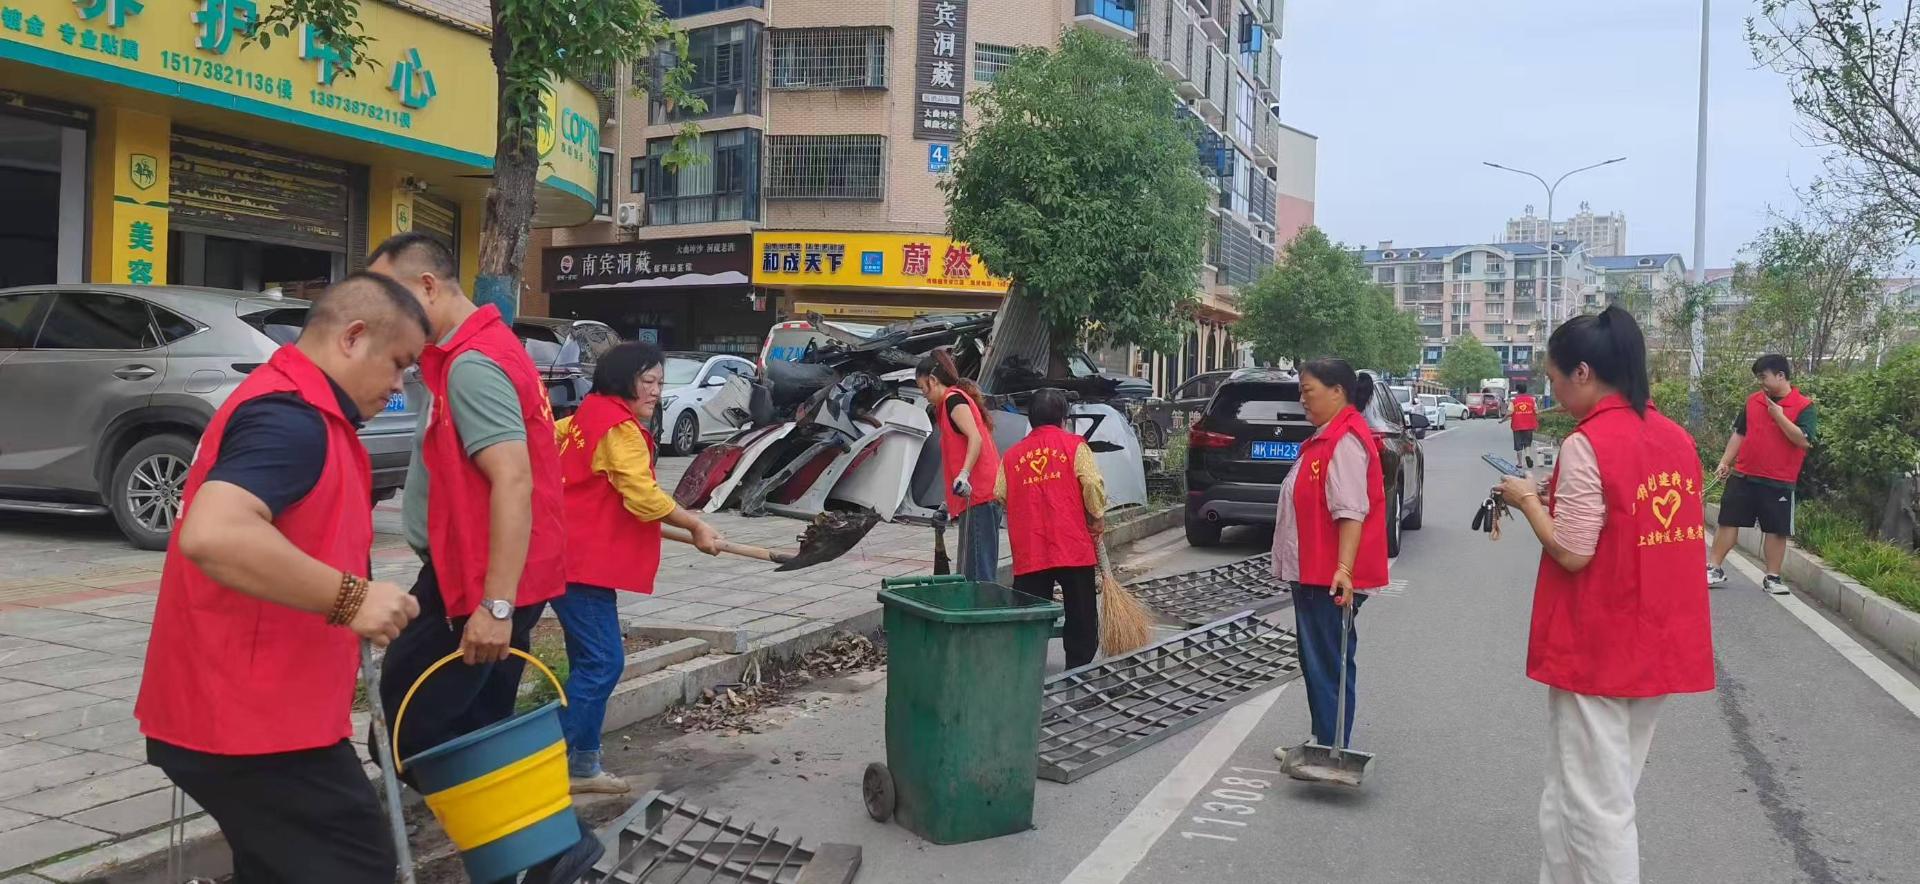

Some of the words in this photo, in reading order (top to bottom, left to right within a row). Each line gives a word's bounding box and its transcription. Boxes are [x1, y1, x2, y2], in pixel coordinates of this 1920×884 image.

[931, 1, 957, 88] 宾洞藏
[128, 221, 154, 285] 美容
[581, 250, 653, 276] 南宾洞藏
[763, 252, 844, 273] 和成天下
[902, 242, 993, 279] 蔚然
[1253, 443, 1299, 459] 湘KHH23
[1180, 766, 1283, 841] 113081
